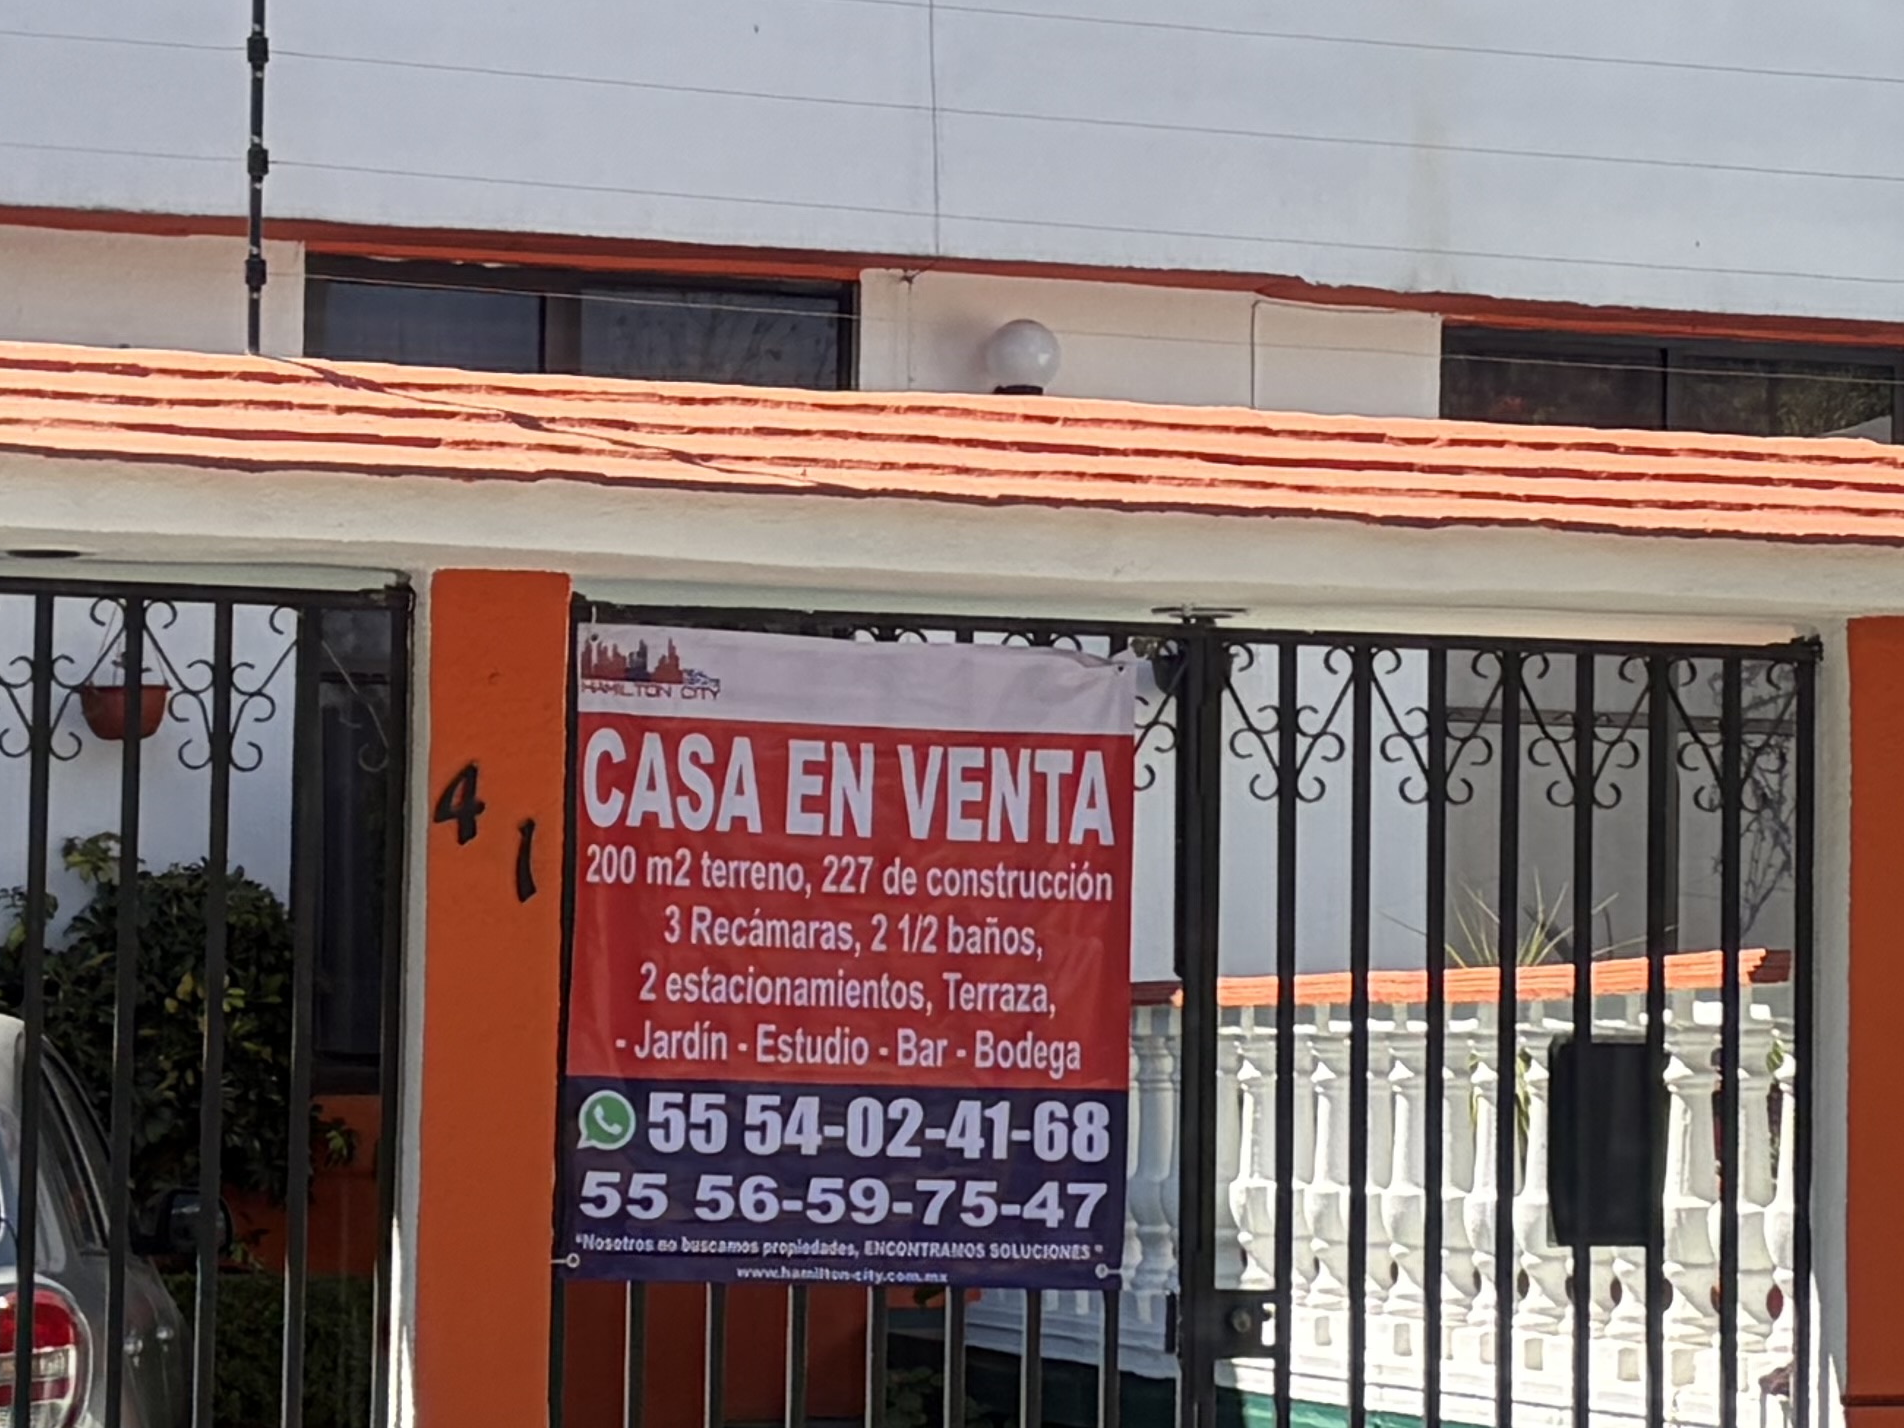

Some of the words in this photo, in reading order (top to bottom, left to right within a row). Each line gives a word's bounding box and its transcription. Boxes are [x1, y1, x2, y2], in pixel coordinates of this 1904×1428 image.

[581, 681, 672, 698] HAMILTON
[680, 685, 721, 700] CITY
[583, 728, 763, 833] CASA
[785, 739, 874, 839] EN
[897, 744, 1115, 846] VENTA
[586, 844, 637, 885] 200
[646, 849, 691, 887] m2
[702, 850, 813, 898] terreno,
[822, 856, 874, 894] 227
[883, 859, 917, 897] de
[926, 861, 1113, 901] construcción
[664, 905, 682, 944] 3
[691, 907, 860, 957] Recámaras,
[871, 914, 888, 952] 2
[897, 915, 939, 955] 1/2
[947, 914, 1044, 961] baños,
[640, 962, 657, 1002] 2
[665, 966, 933, 1016] estacionamientos,
[943, 972, 1057, 1019] Terraza,
[634, 1019, 728, 1061] Jardín
[756, 1023, 870, 1066] Estudio
[897, 1028, 948, 1068] Bar
[974, 1030, 1082, 1080] Bodega
[647, 1091, 728, 1154] 55
[744, 1095, 1111, 1162] 54-02-41-68
[579, 1172, 669, 1220] 55
[694, 1174, 1109, 1229] 56-59-75-47
[657, 1238, 678, 1252] no
[680, 1236, 759, 1254] buscamos
[762, 1238, 859, 1258] propiedades,
[864, 1240, 986, 1259] ENCONTRAMOS
[989, 1243, 1091, 1260] SOLUCIONES
[736, 1266, 948, 1284] www.hamilton-city.com.mx
